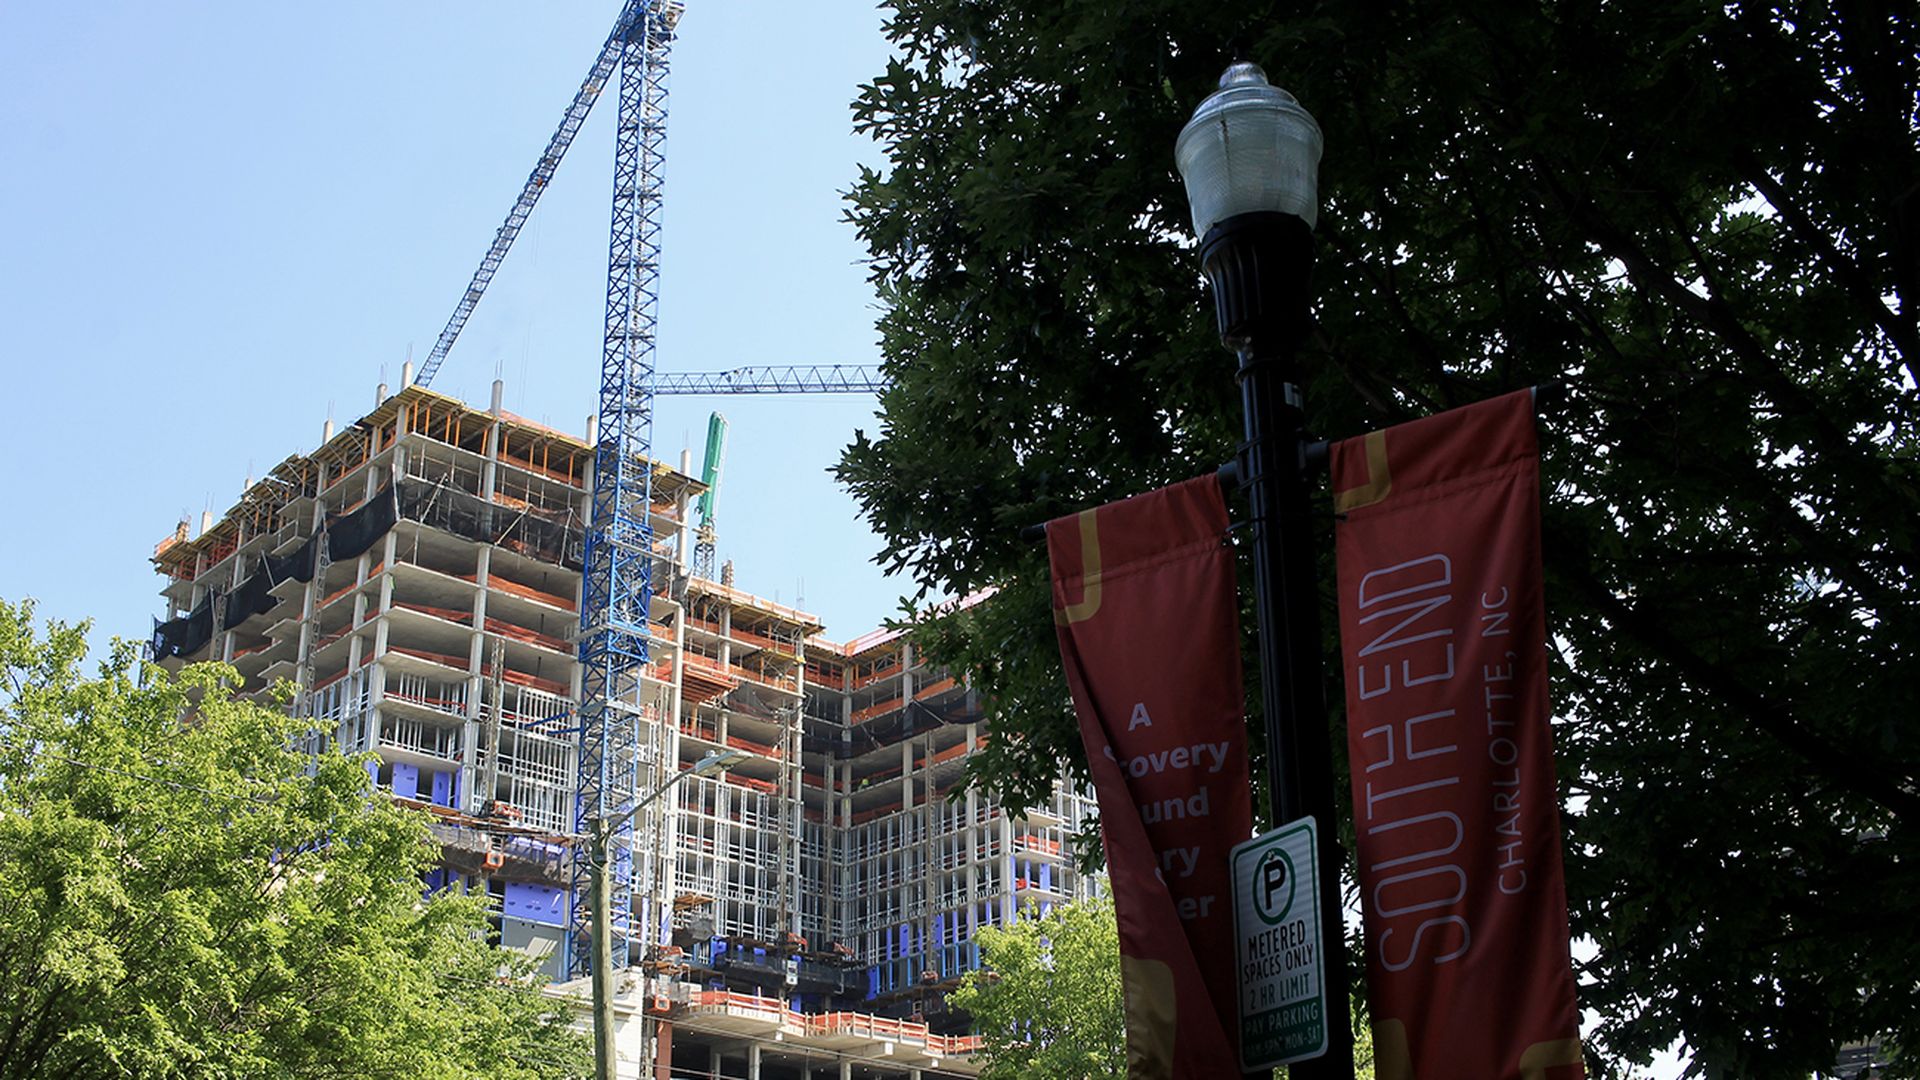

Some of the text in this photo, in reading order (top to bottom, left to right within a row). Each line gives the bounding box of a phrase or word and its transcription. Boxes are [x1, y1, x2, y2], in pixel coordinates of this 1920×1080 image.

[1128, 703, 1152, 731] A
[1481, 586, 1527, 895] CHARLOTTE, NC
[1358, 553, 1471, 972] SOUTH END
[1264, 860, 1286, 910] P
[1248, 920, 1305, 960] METERED
[1244, 944, 1313, 984] SPACES ONLY
[1249, 973, 1310, 1010] 2 HR LIMIT
[1245, 1002, 1318, 1038] PAY PARKING
